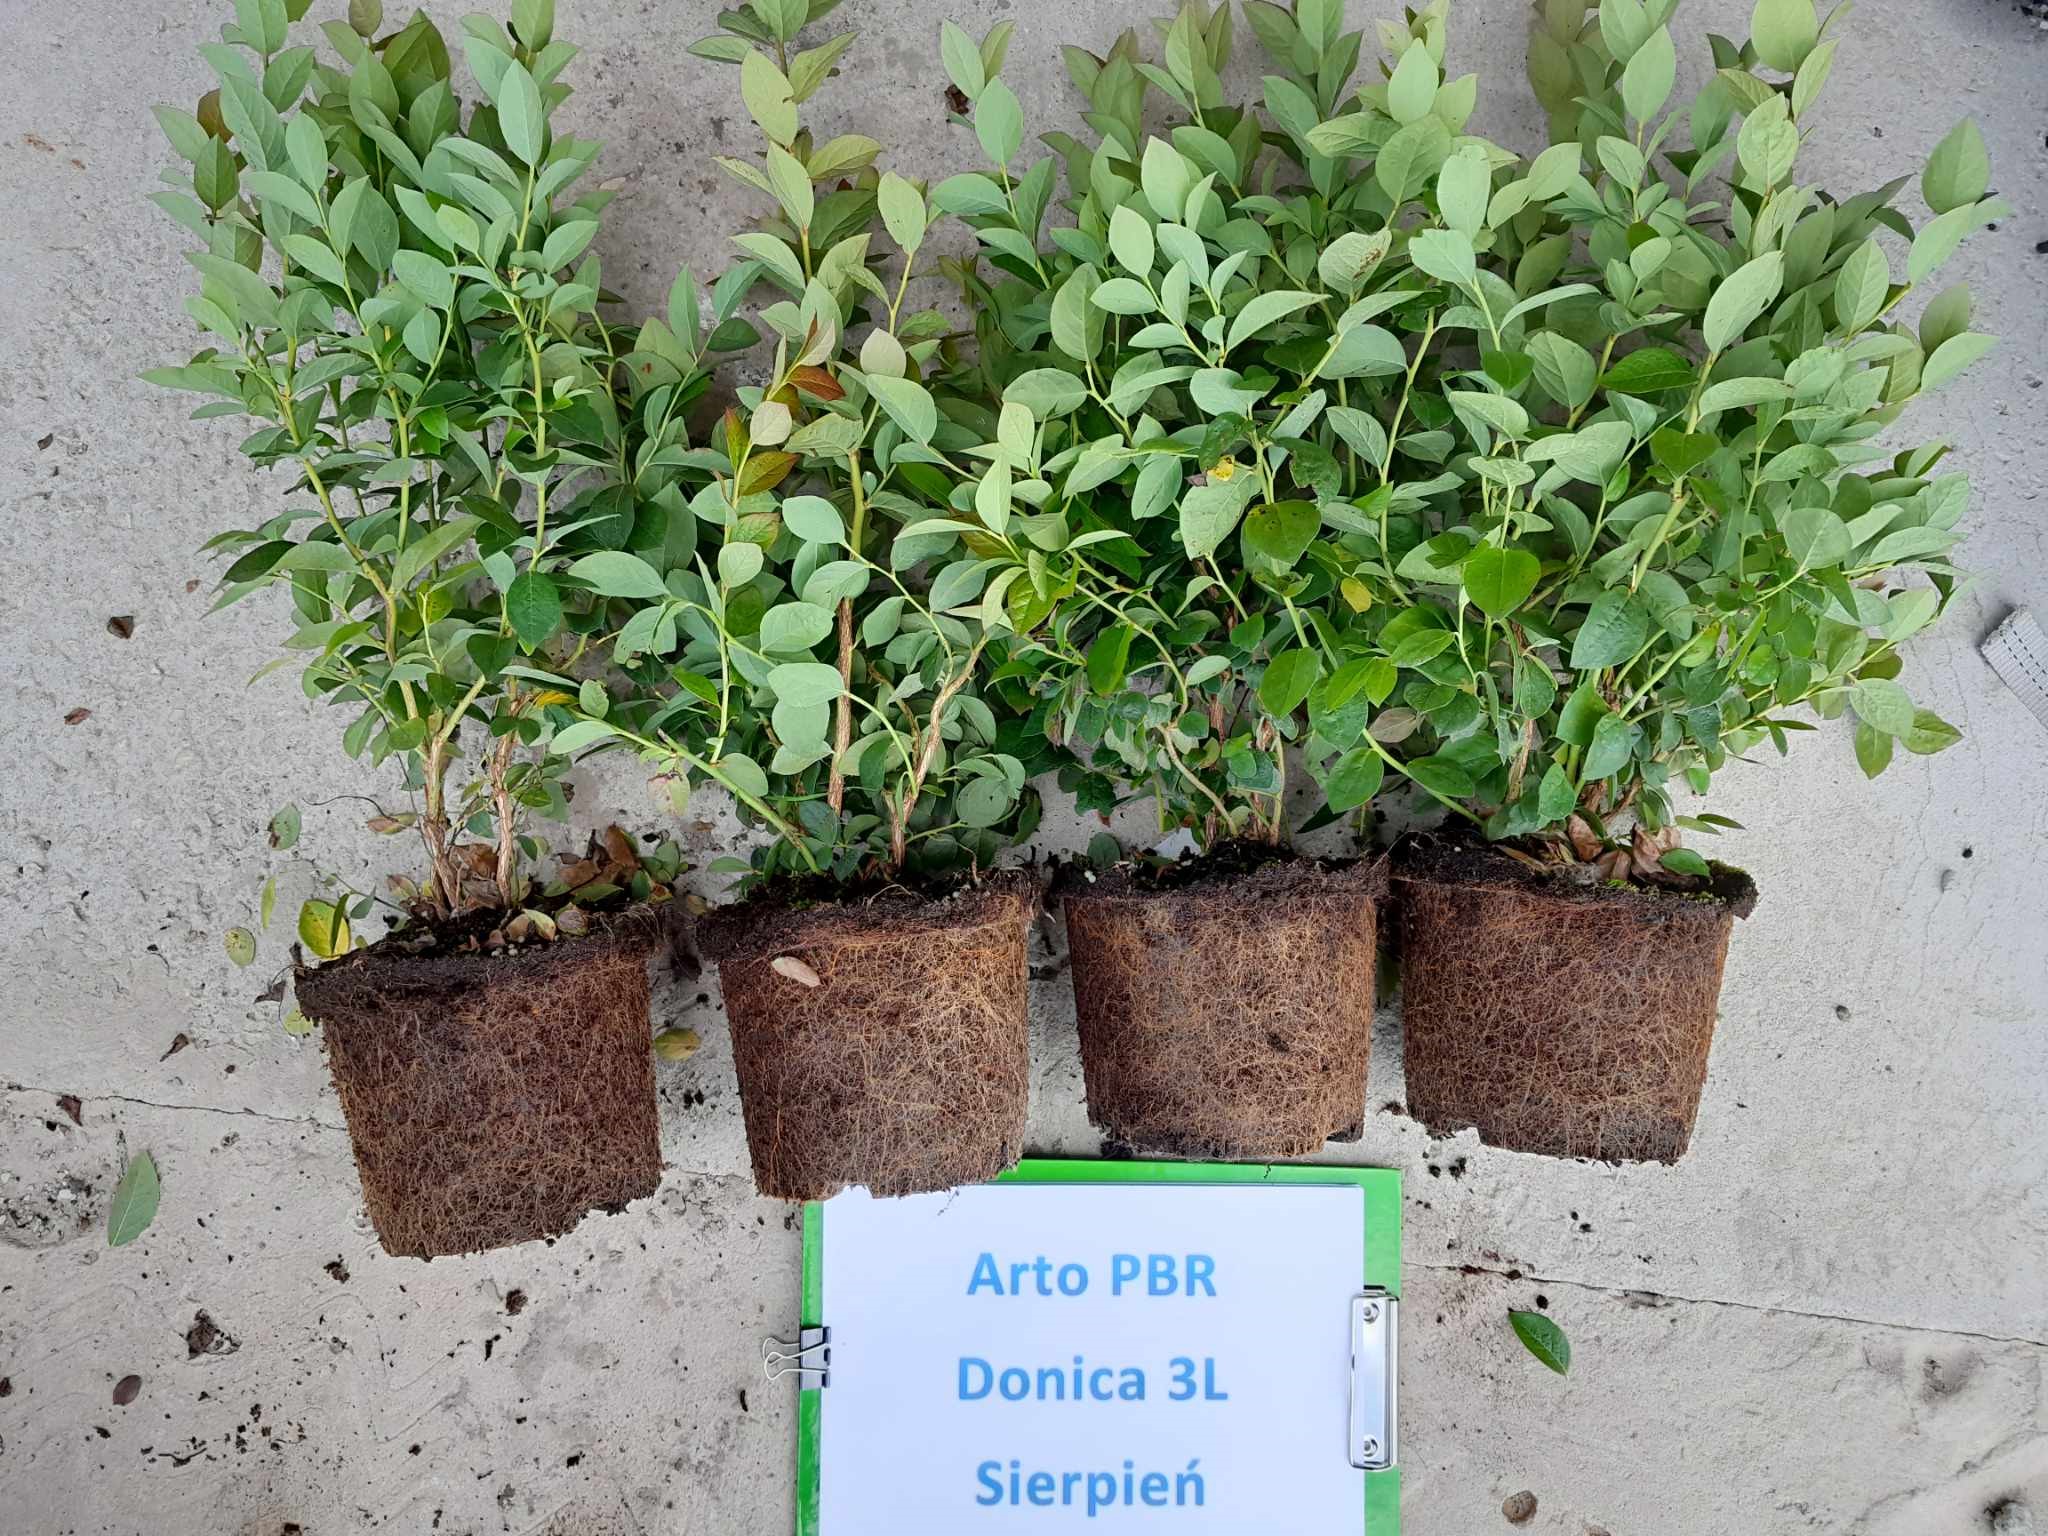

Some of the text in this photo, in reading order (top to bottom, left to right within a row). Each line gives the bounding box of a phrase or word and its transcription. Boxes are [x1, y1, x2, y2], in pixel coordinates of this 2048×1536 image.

[966, 1252, 1218, 1298] Arto PBR
[956, 1353, 1231, 1404] Donica 3L
[975, 1456, 1207, 1520] Sierpień
